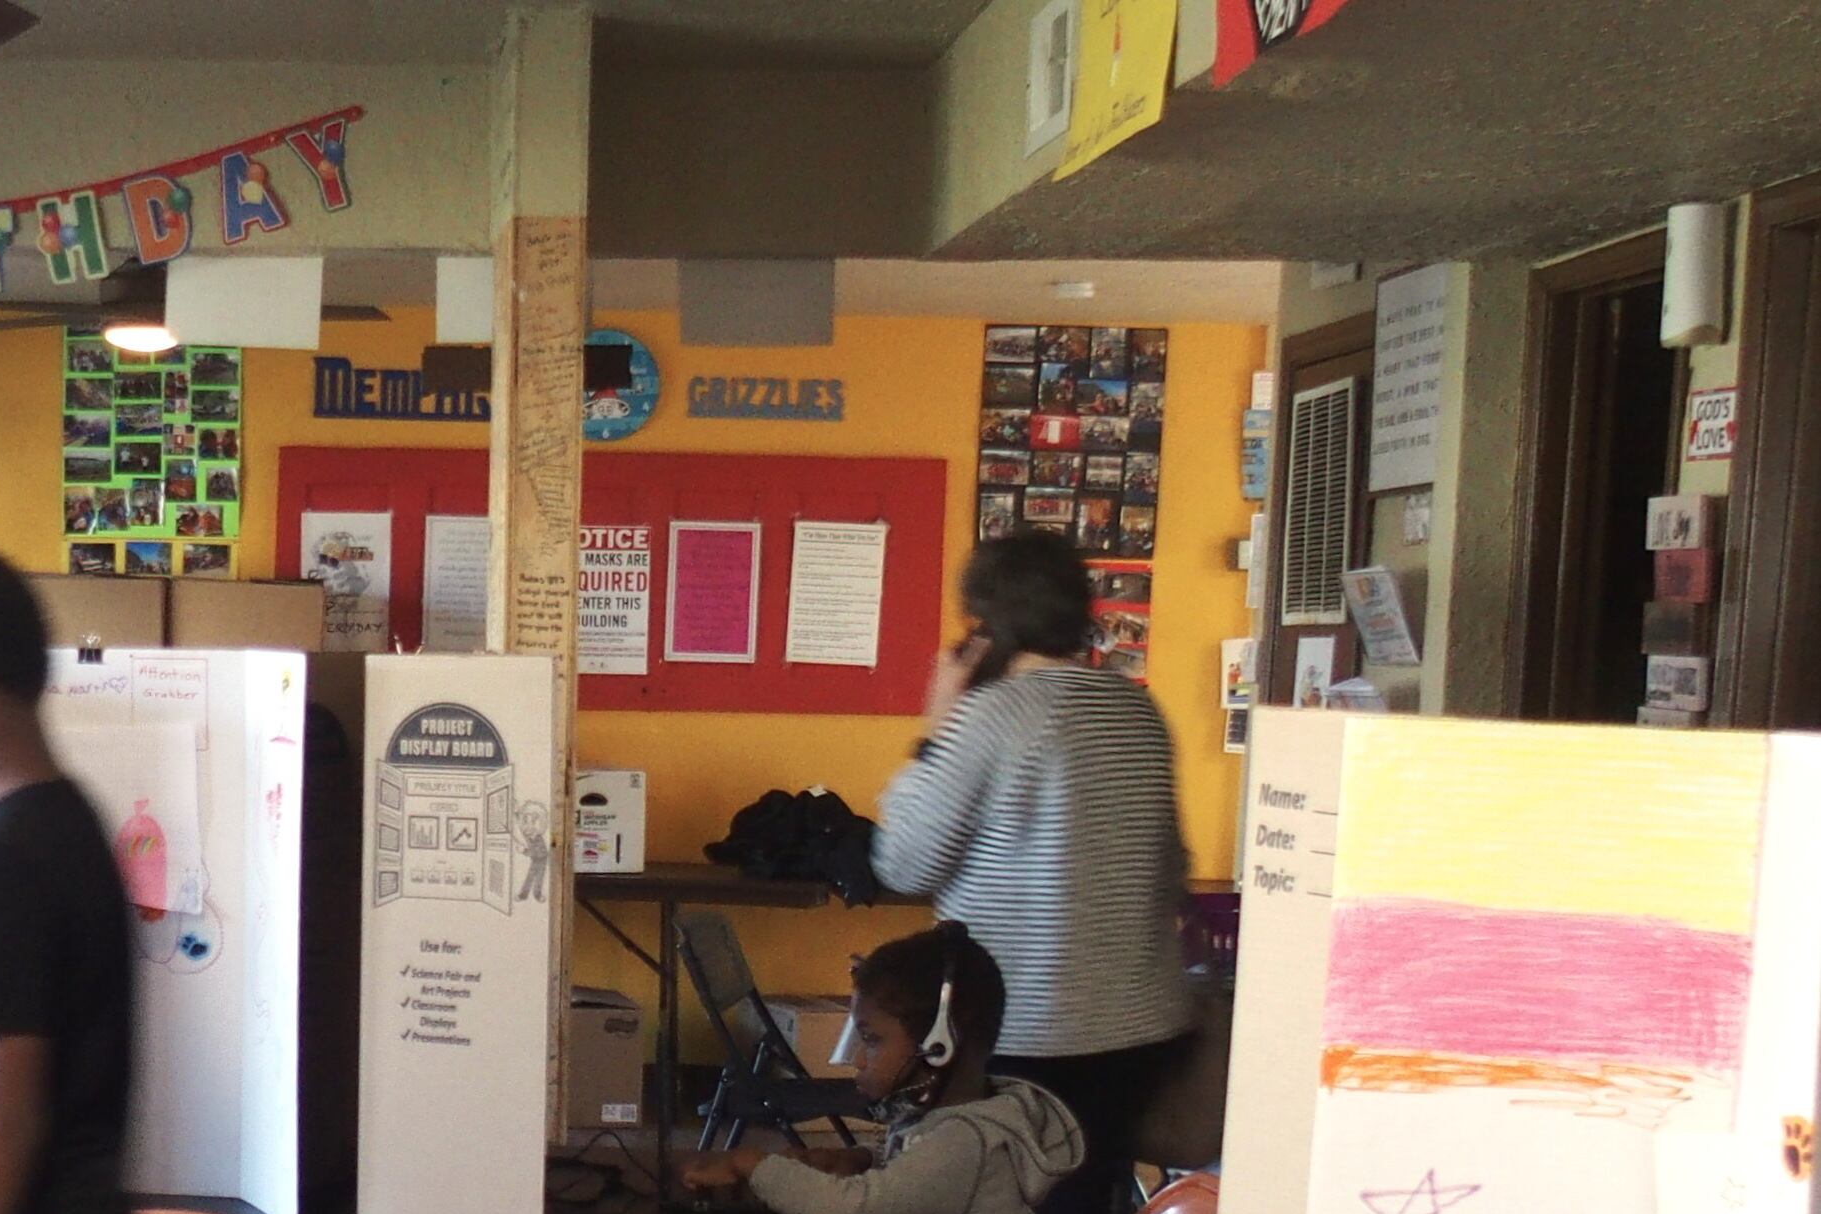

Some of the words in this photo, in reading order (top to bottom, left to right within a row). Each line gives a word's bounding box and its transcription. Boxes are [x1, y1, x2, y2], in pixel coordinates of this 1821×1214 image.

[687, 375, 845, 421] GRIZZLIES
[1696, 397, 1730, 421] GOD'S
[1696, 428, 1725, 450] LOVE
[580, 529, 649, 549] OTICE
[585, 553, 623, 567] MASKS
[626, 553, 648, 567] ARE
[579, 571, 647, 592] QUIRED
[616, 597, 641, 610] THIS
[326, 622, 383, 634] ERYDAY
[421, 718, 473, 737] PROJECT
[400, 739, 450, 757] DISPLAY
[452, 740, 494, 757] BOARD
[1259, 783, 1307, 810] Name:
[1255, 824, 1296, 850] Date:
[1253, 865, 1296, 895] Topic:
[420, 940, 440, 954] Use
[442, 941, 461, 955] for:
[412, 968, 443, 981] Science
[445, 969, 463, 981] Fair
[464, 970, 481, 983] and
[420, 985, 435, 996] Art
[437, 985, 471, 999] Projects
[411, 1000, 457, 1013] Classroom
[419, 1016, 457, 1030] Displays
[412, 1032, 471, 1046] Presentations
